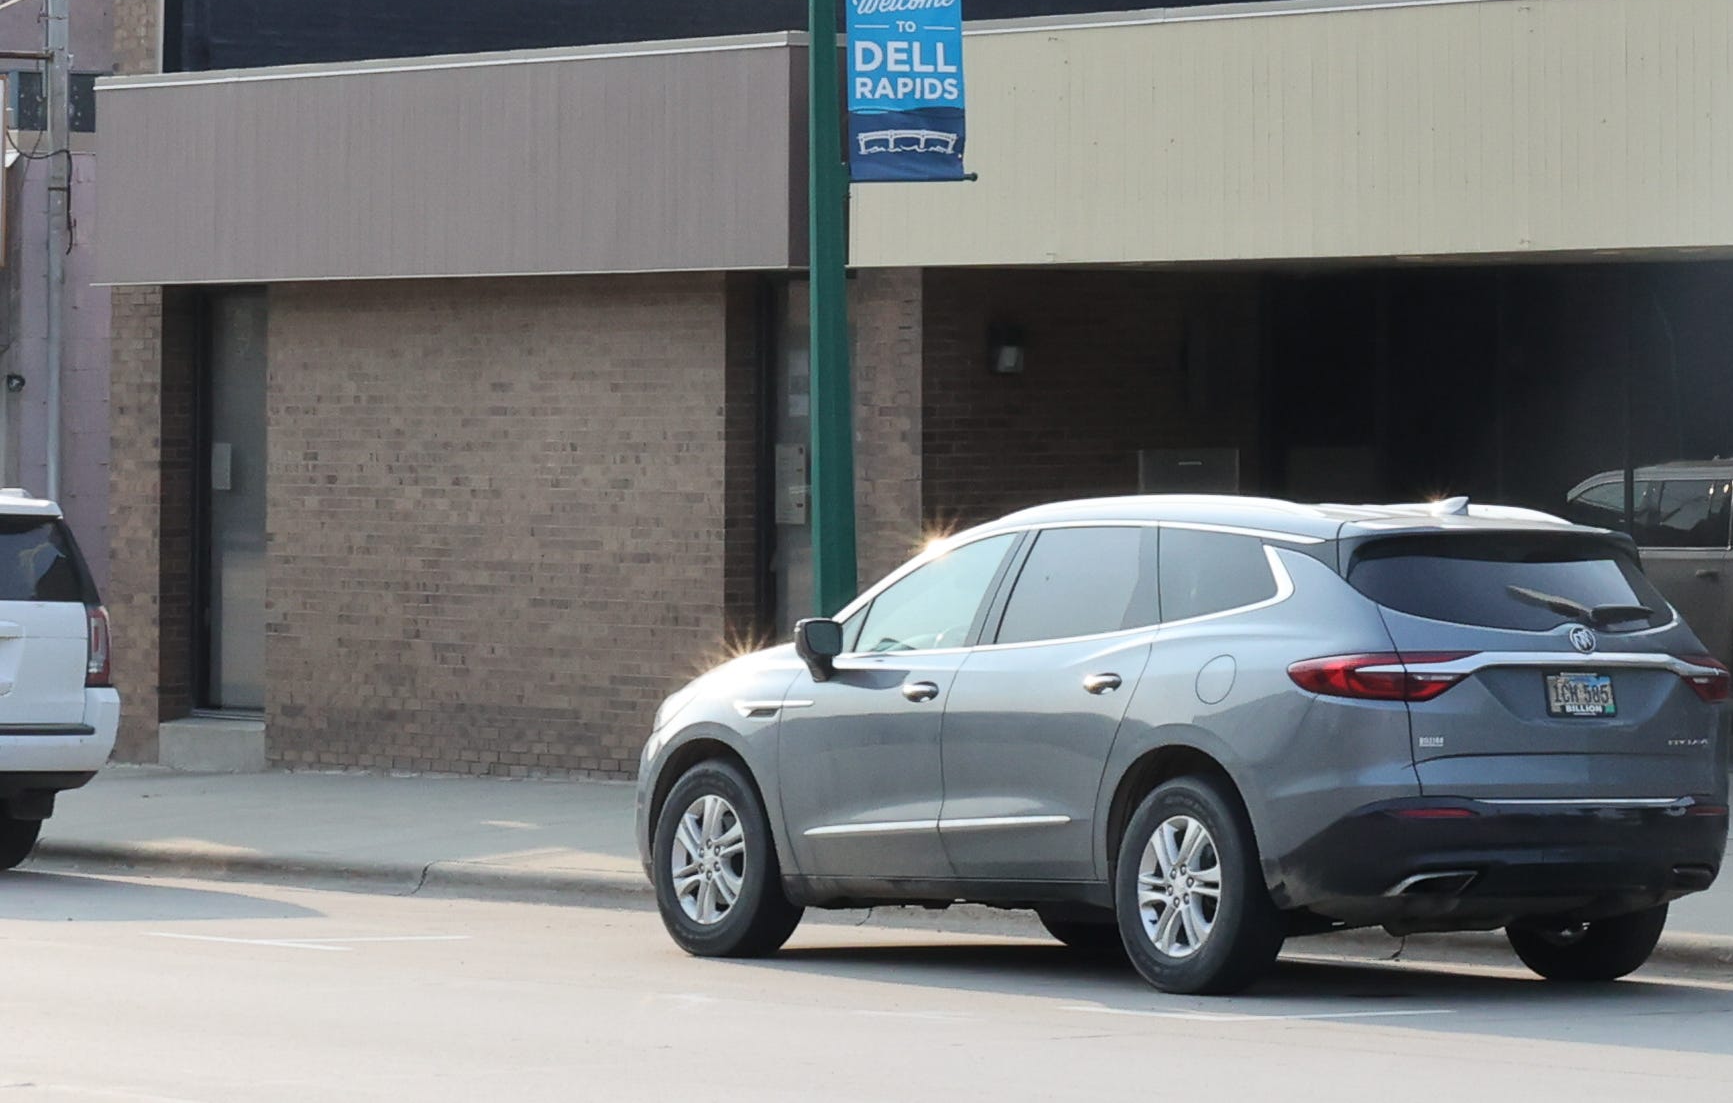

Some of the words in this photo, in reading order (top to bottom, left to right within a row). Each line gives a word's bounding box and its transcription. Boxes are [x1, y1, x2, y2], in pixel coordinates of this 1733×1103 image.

[895, 20, 917, 33] TO
[854, 40, 957, 73] DELL
[855, 77, 959, 100] RAPIDS
[1565, 705, 1603, 713] BILLION
